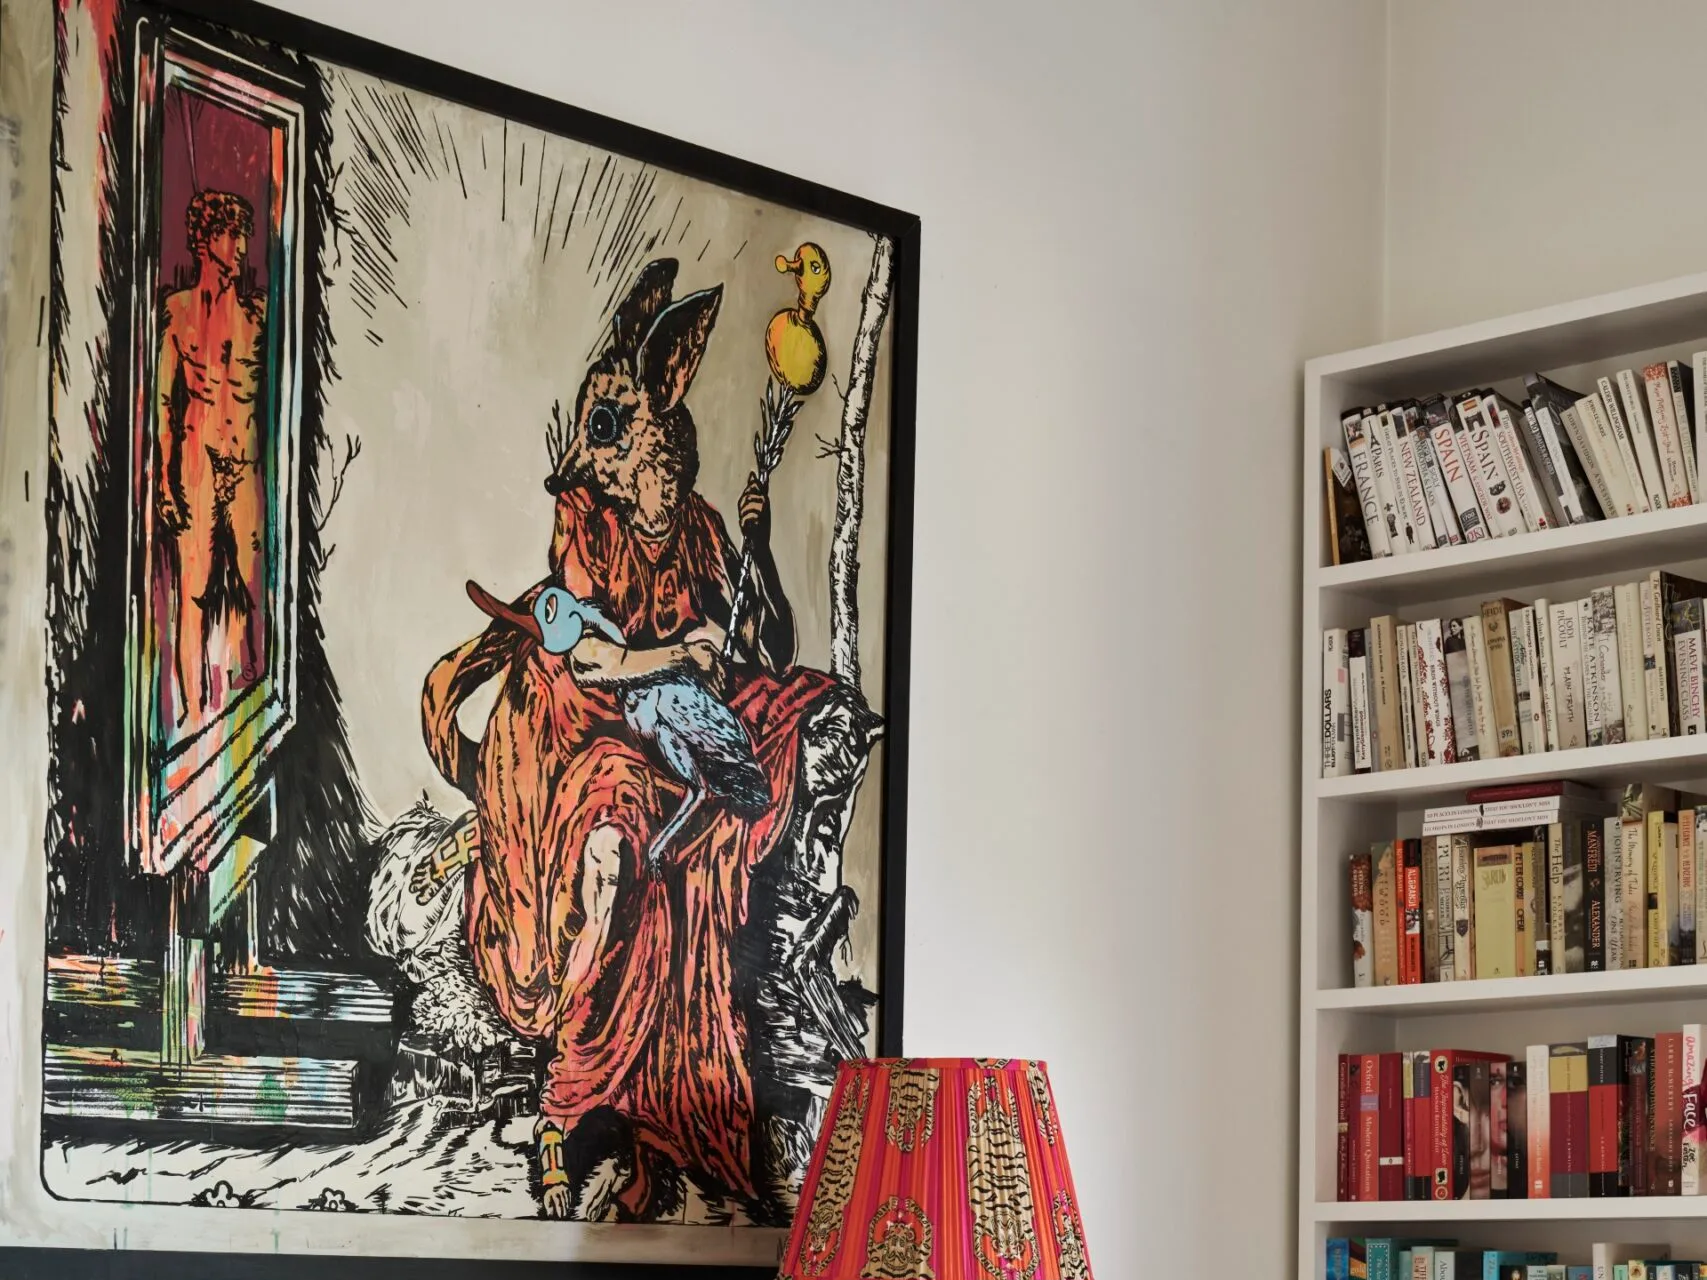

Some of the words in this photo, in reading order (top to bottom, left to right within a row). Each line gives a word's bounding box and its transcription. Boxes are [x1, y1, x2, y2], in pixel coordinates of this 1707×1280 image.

[1370, 447, 1384, 479] PARIS
[1434, 428, 1464, 484] SPAIN
[1458, 432, 1476, 473] VIETNAM
[1471, 429, 1498, 481] SPAIN
[1499, 432, 1522, 481] SOUTHWEST
[1515, 480, 1527, 500] USA
[1353, 455, 1380, 528] FRANCE
[1400, 441, 1414, 468] NEW
[1407, 466, 1426, 527] ZEALAND
[1594, 472, 1618, 517] ANCESTORS
[1557, 610, 1568, 648] PICOULT
[1565, 617, 1575, 639] JODI
[1586, 616, 1597, 649] KATE
[1678, 640, 1688, 689] EVENING
[1687, 637, 1698, 673] MAEVE
[1431, 681, 1439, 708] WITHOUT
[1562, 667, 1571, 693] PLAIN
[1589, 654, 1601, 722] ATKINSON
[1689, 675, 1702, 718] BINCHY
[1565, 695, 1574, 723] TRUTH
[1681, 690, 1691, 721] CLASS
[1553, 838, 1561, 854] The
[1586, 829, 1598, 873] MANFREDI
[1614, 834, 1623, 862] JOHN
[1550, 855, 1563, 885] Help
[1615, 864, 1623, 904] IRVING
[1591, 899, 1601, 950] ALEXANDER
[1667, 1038, 1675, 1064] LARRY
[1682, 1036, 1697, 1088] amazing
[1365, 1060, 1374, 1093] Oxford
[1365, 1116, 1374, 1147] Modern
[1683, 1092, 1698, 1135] Face
[1365, 1149, 1374, 1193] Quotations
